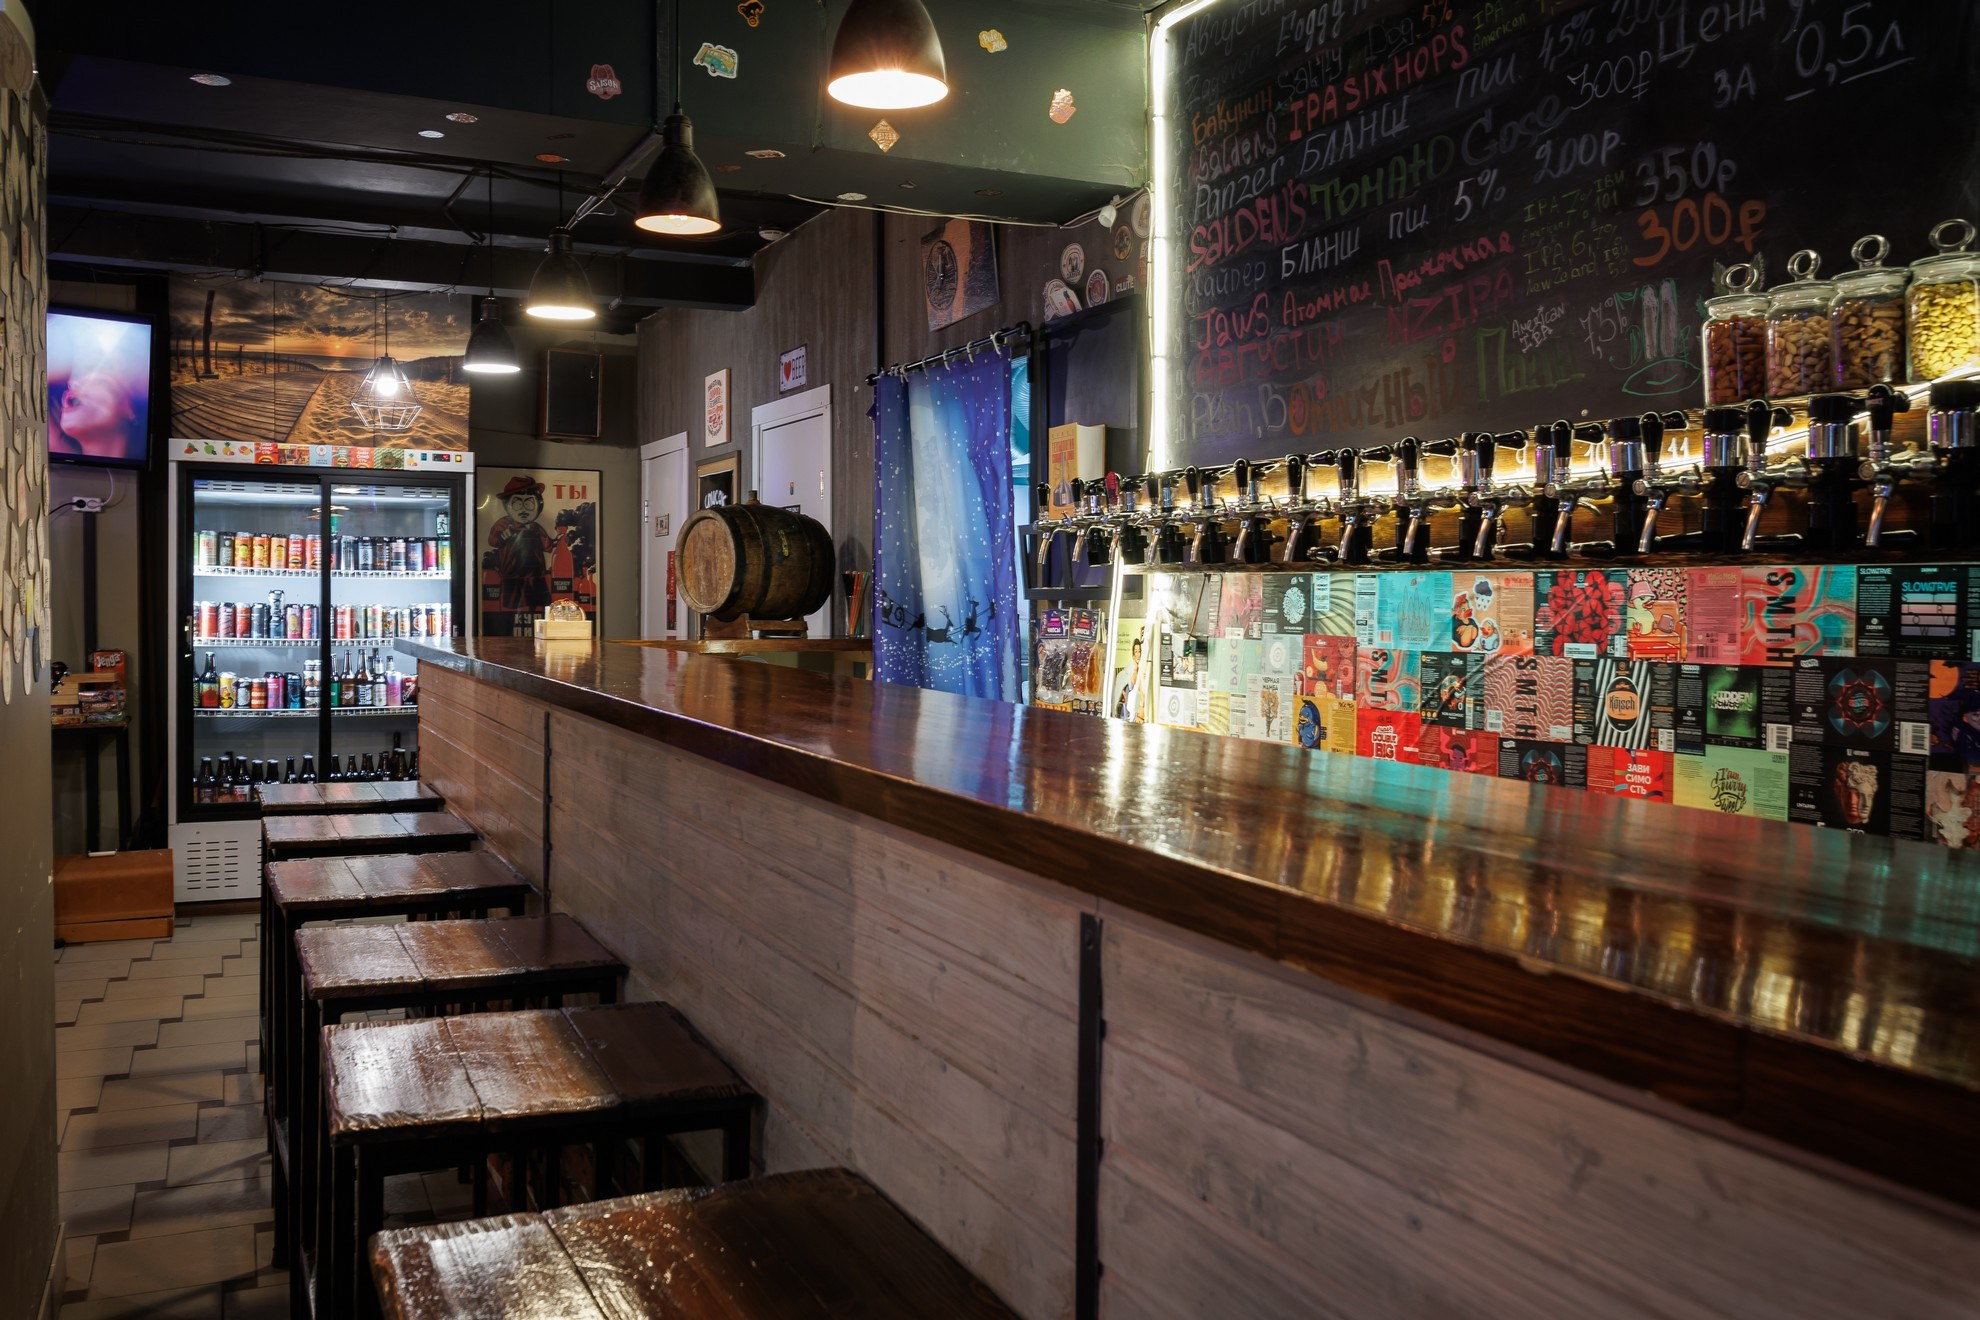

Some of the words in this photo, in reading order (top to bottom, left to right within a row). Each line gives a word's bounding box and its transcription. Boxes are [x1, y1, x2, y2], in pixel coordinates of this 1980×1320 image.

[1289, 84, 1339, 142] IPA
[1343, 63, 1388, 111] SIX
[1394, 24, 1469, 91] HOPS
[1193, 154, 1286, 225] Panzer
[1453, 167, 1507, 223] 5%
[1667, 436, 1691, 460] 11
[552, 483, 588, 501] ТЫ
[1765, 571, 1796, 662] SMITH
[96, 653, 121, 668] Jenga
[1515, 657, 1538, 738] SMITH
[1374, 743, 1395, 759] BIG
[1625, 773, 1652, 784] СИМО
[1626, 763, 1650, 774] ЗАВИ
[1629, 785, 1647, 795] СТЬ
